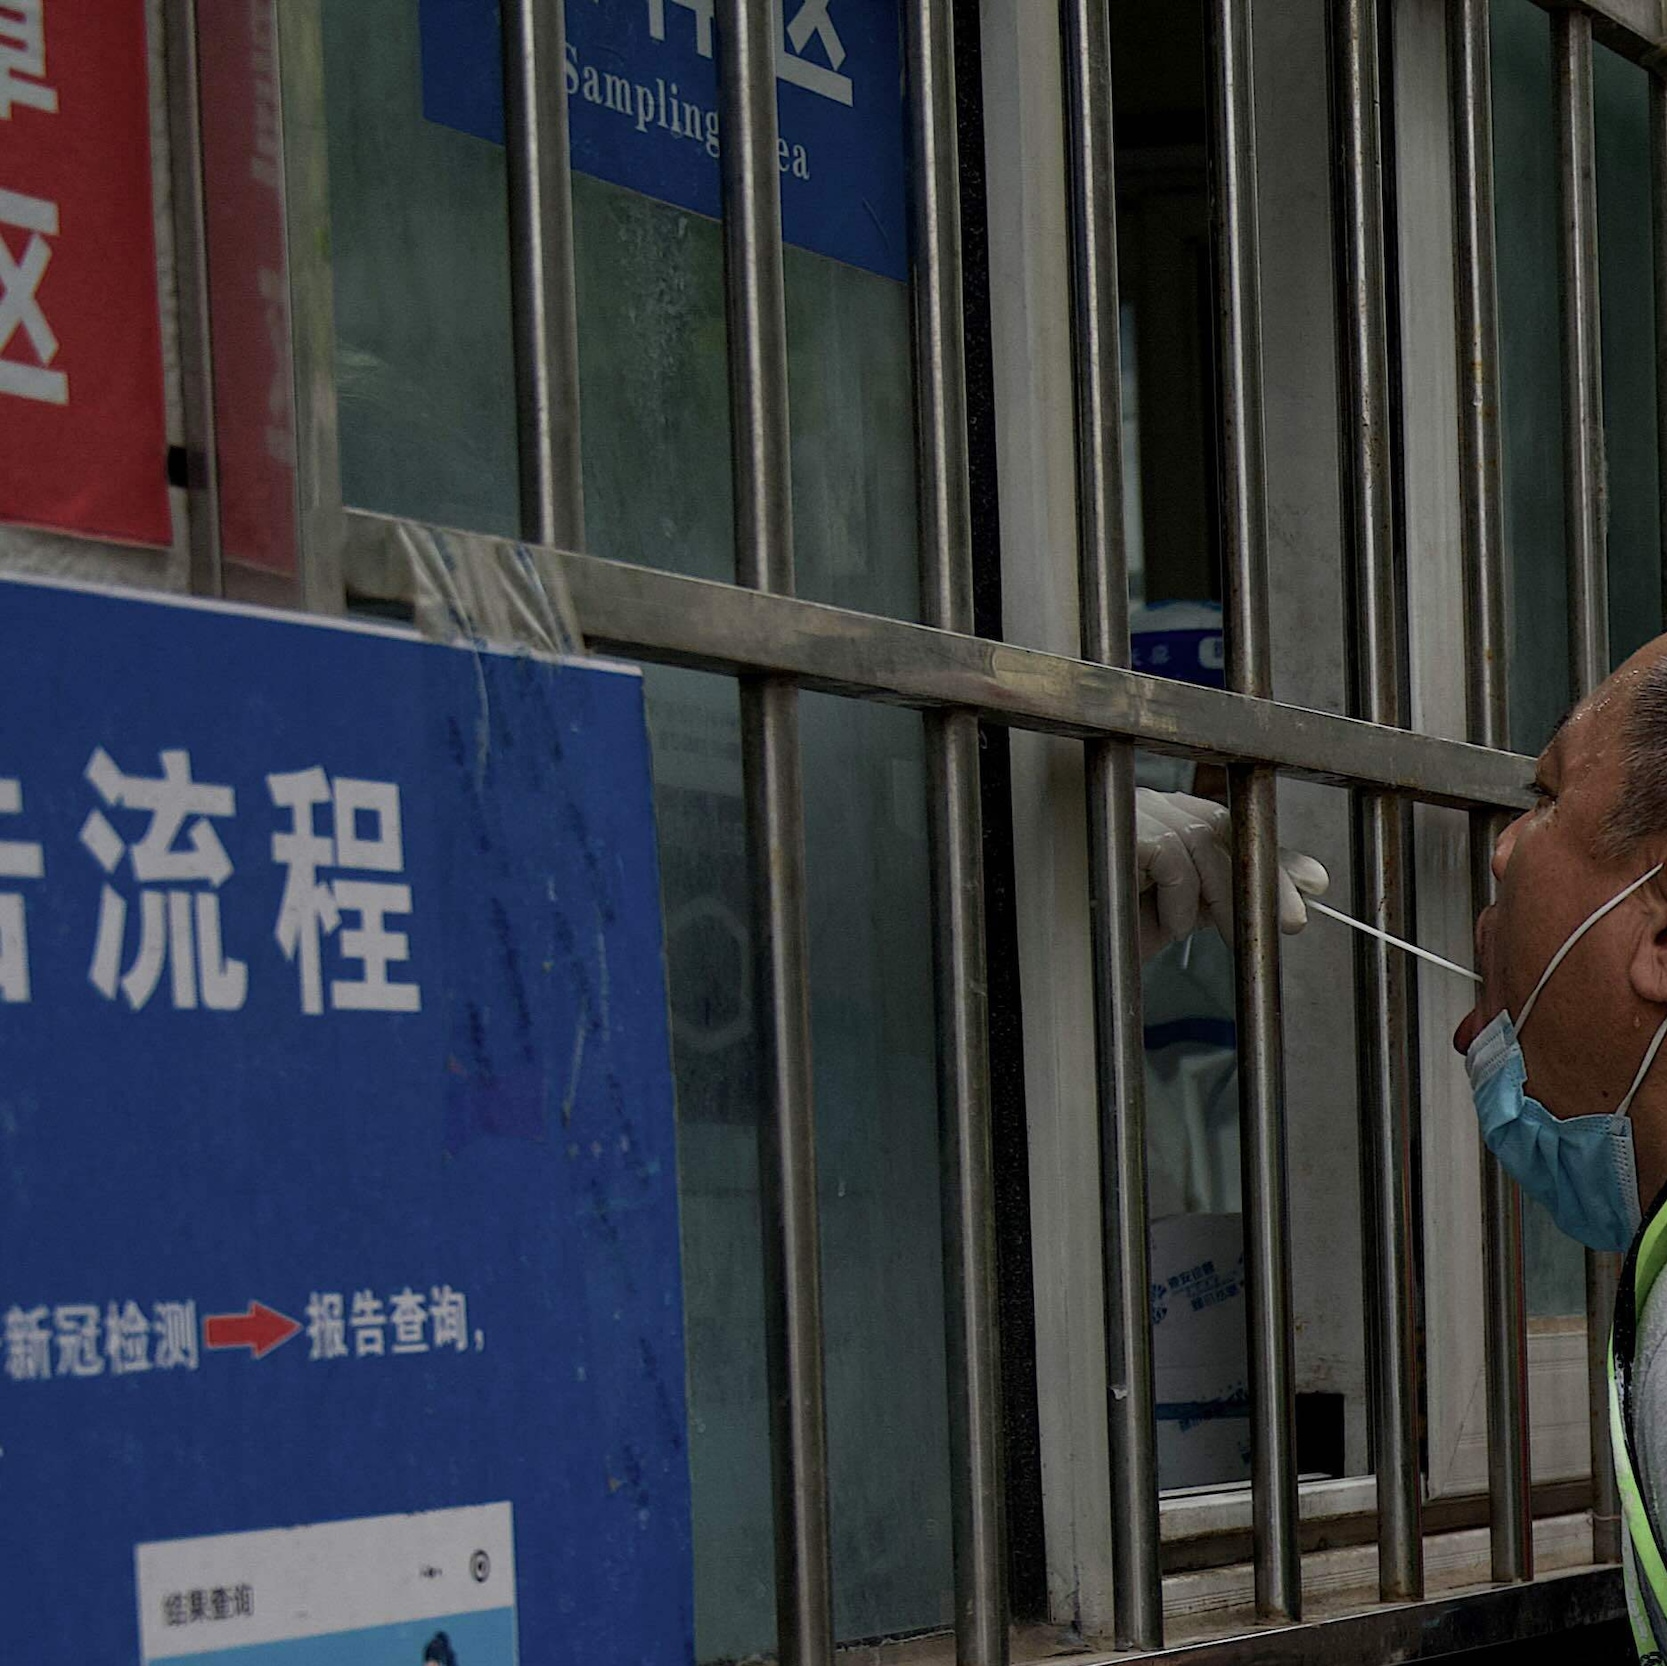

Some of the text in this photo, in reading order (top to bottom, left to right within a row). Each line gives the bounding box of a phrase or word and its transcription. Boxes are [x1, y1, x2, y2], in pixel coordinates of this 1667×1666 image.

[564, 41, 721, 159] Sampling
[0, 745, 422, 1014] 流程
[3, 1300, 199, 1380] 新冠检测
